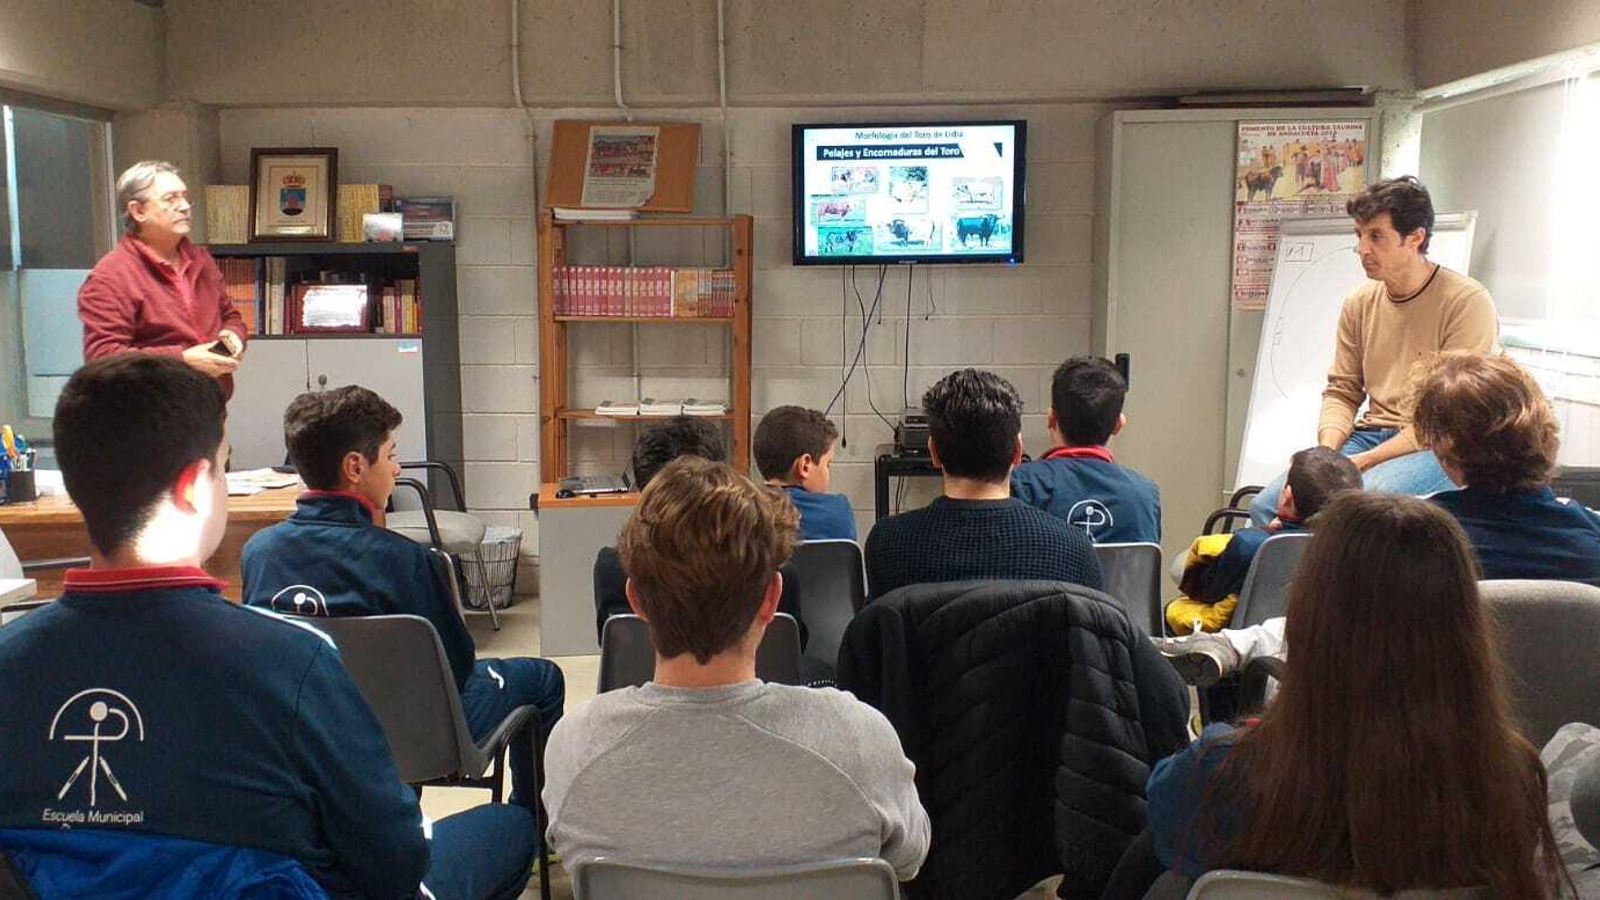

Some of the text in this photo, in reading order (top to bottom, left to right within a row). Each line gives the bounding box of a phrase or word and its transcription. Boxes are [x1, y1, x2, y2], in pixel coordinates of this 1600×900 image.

[900, 131, 912, 139] del
[823, 146, 960, 160] Pelajes y Encornaduras del Toro
[42, 808, 144, 825] Escuela Municipal
